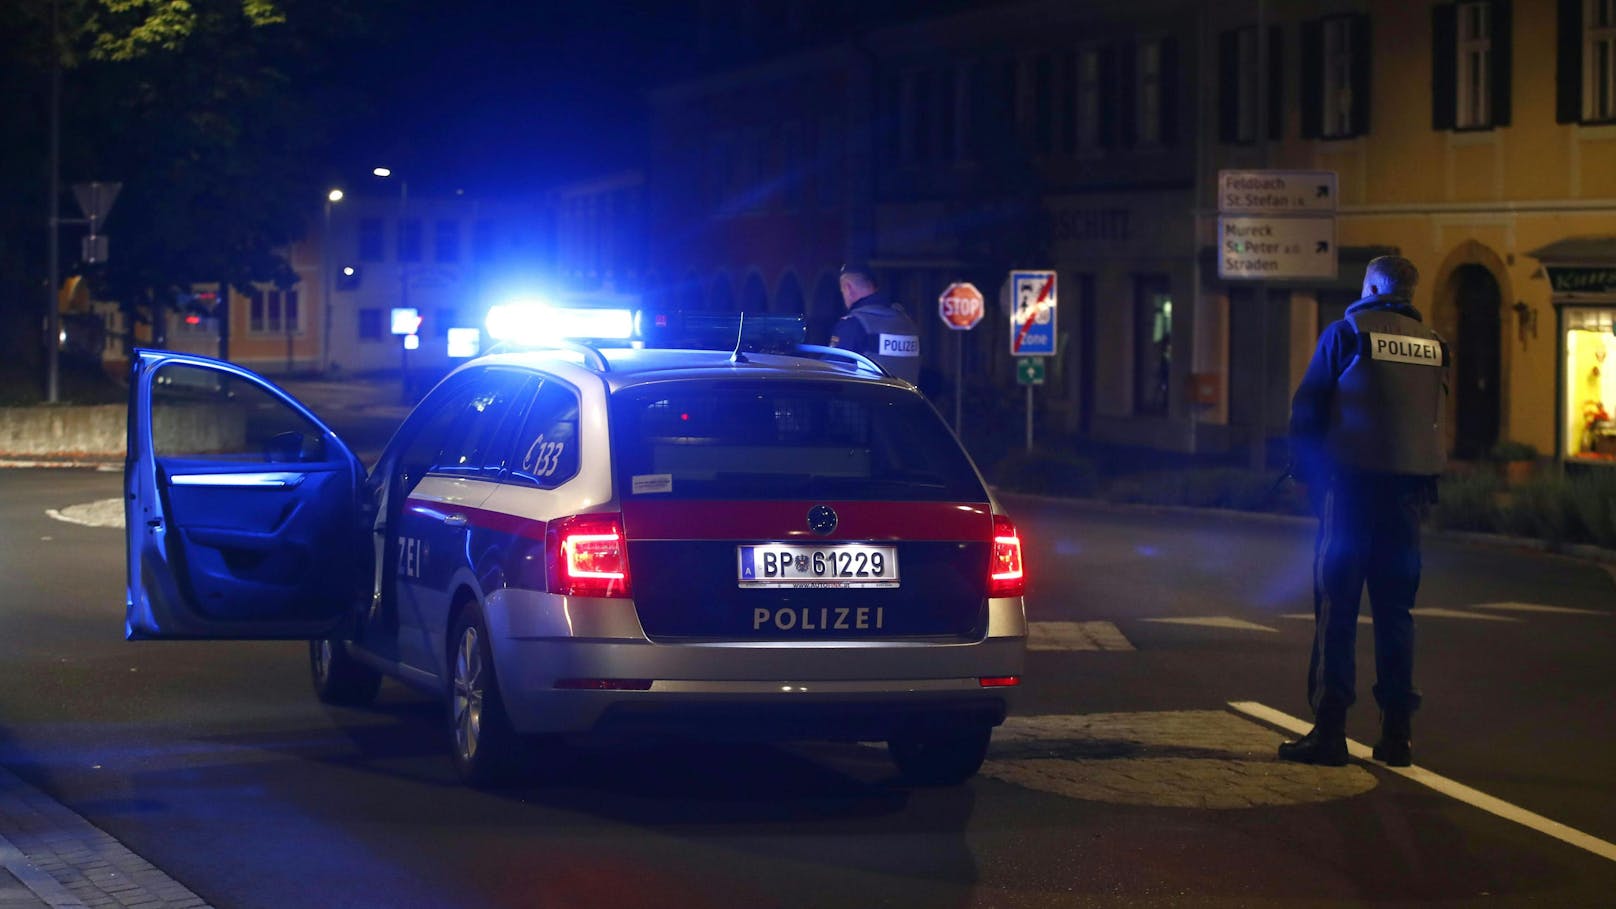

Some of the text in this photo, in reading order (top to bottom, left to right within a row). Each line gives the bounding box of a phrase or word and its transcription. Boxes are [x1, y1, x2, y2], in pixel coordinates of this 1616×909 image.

[1226, 177, 1286, 190] Feldbach
[1226, 224, 1273, 237] Mureck
[1226, 258, 1279, 271] Straden
[944, 298, 979, 316] STOP
[1377, 339, 1437, 360] POLIZEI
[533, 442, 565, 477] 133
[744, 551, 885, 578] A BP 61229
[753, 607, 884, 630] POLIZEI
